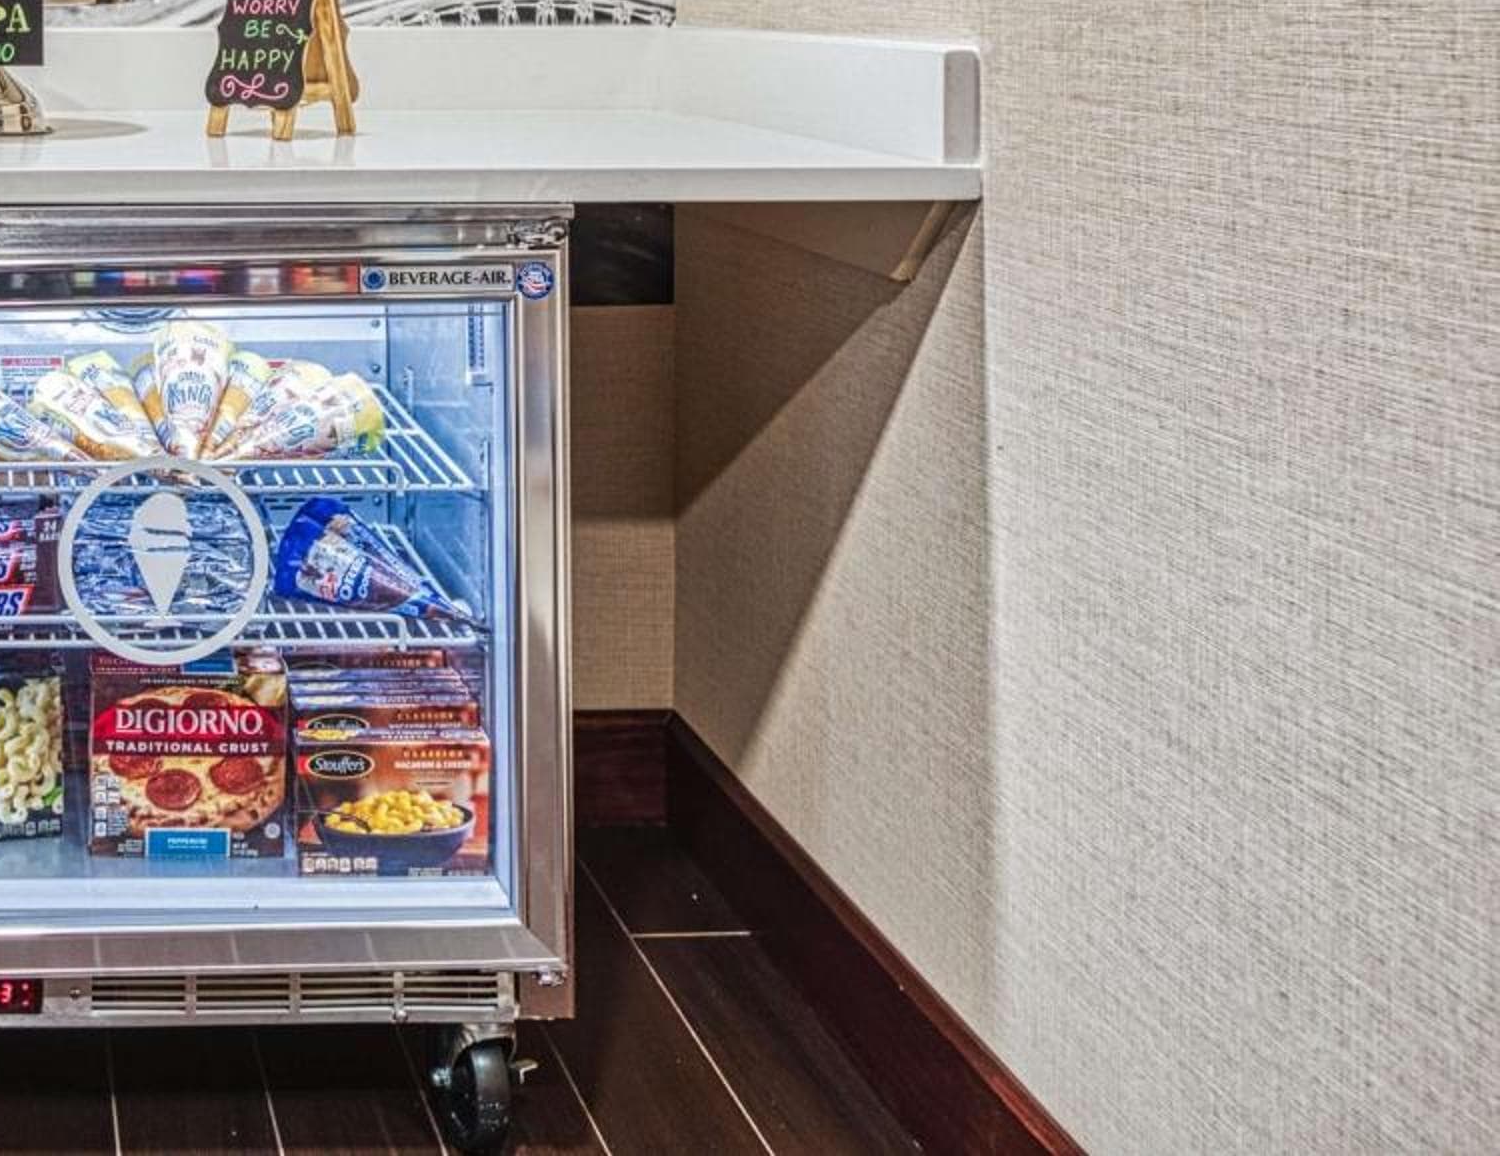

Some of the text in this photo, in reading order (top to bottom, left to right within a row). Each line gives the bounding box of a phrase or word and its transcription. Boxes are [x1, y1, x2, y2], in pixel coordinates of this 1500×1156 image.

[243, 19, 273, 38] BE
[219, 49, 295, 73] HAPPY
[106, 740, 269, 754] TRADITIONAL CRUST
